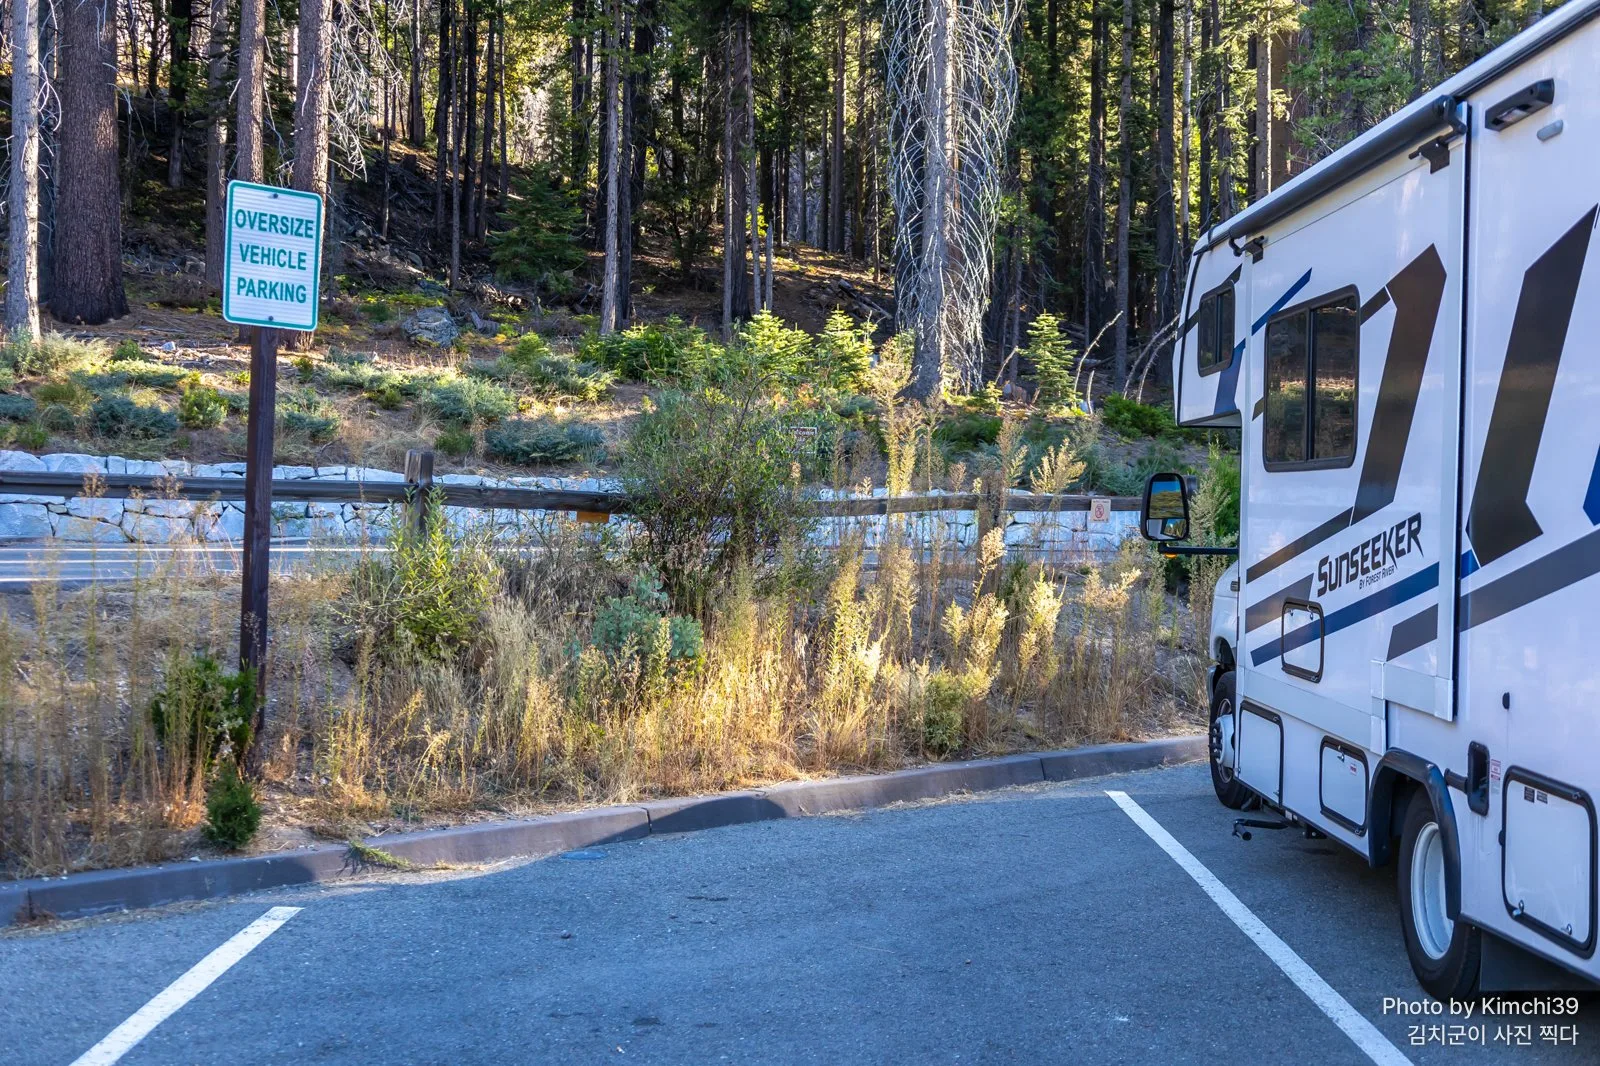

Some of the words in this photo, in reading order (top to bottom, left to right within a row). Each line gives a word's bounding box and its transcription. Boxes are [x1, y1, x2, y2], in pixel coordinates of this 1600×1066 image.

[235, 209, 314, 239] OVERSIZE
[239, 243, 307, 271] VEHICLE
[236, 277, 307, 304] PARKING
[1359, 579, 1366, 590] BY
[1365, 571, 1382, 586] FOREST
[1382, 565, 1395, 578] RIVER
